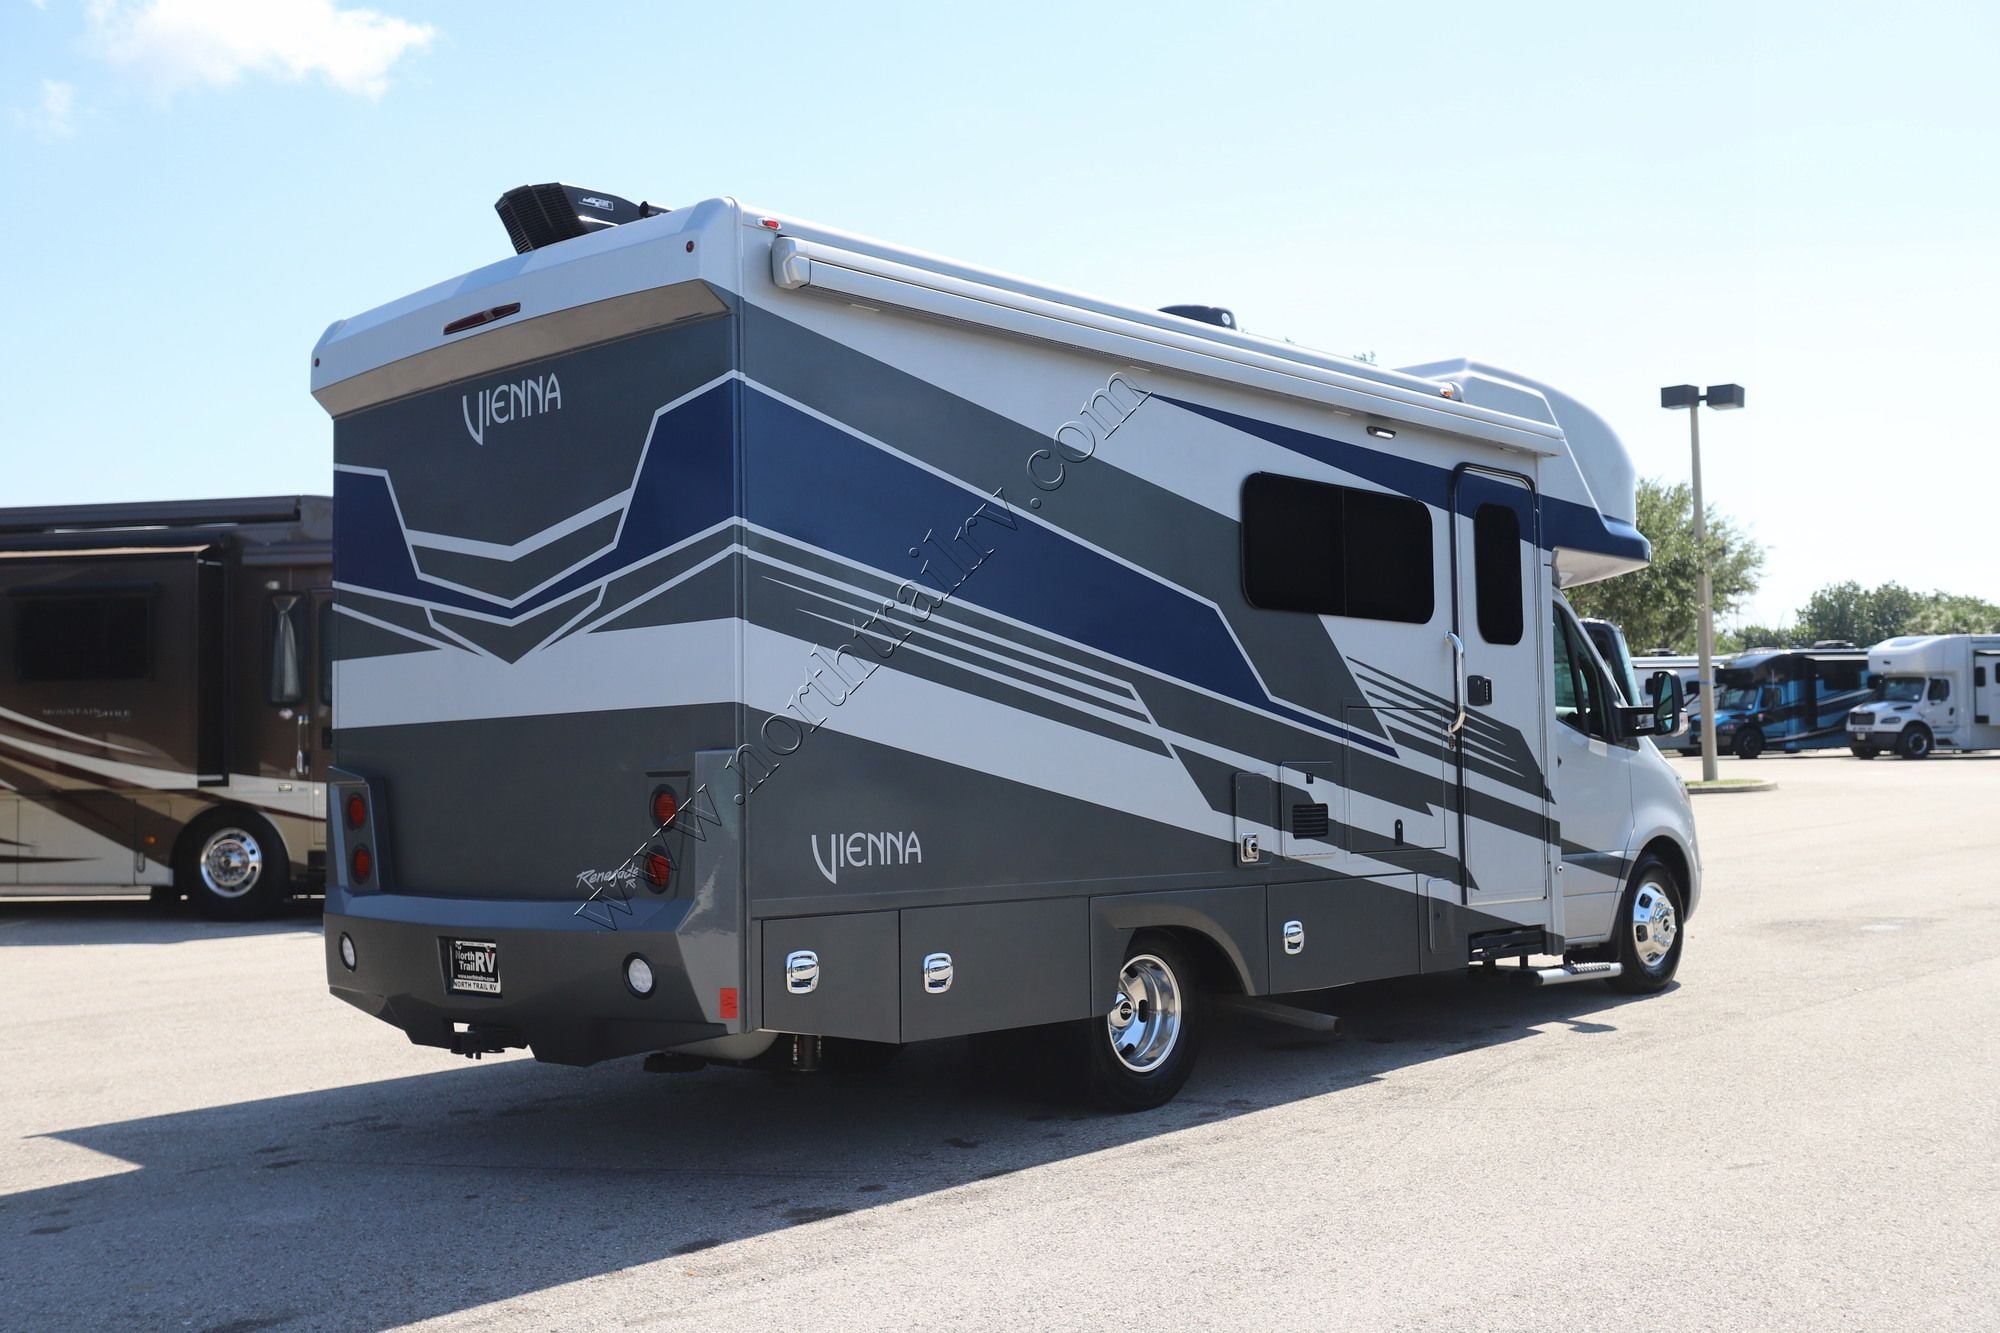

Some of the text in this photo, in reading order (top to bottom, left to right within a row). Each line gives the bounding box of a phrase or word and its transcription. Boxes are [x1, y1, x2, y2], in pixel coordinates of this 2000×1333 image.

[462, 372, 562, 446] VIENNA
[811, 831, 922, 885] VIENNA
[576, 862, 639, 890] Renegade
[455, 950, 475, 961] North
[459, 960, 475, 971] Trail
[475, 951, 496, 973] RV
[472, 982, 488, 990] TRAIL
[489, 983, 497, 991] RV
